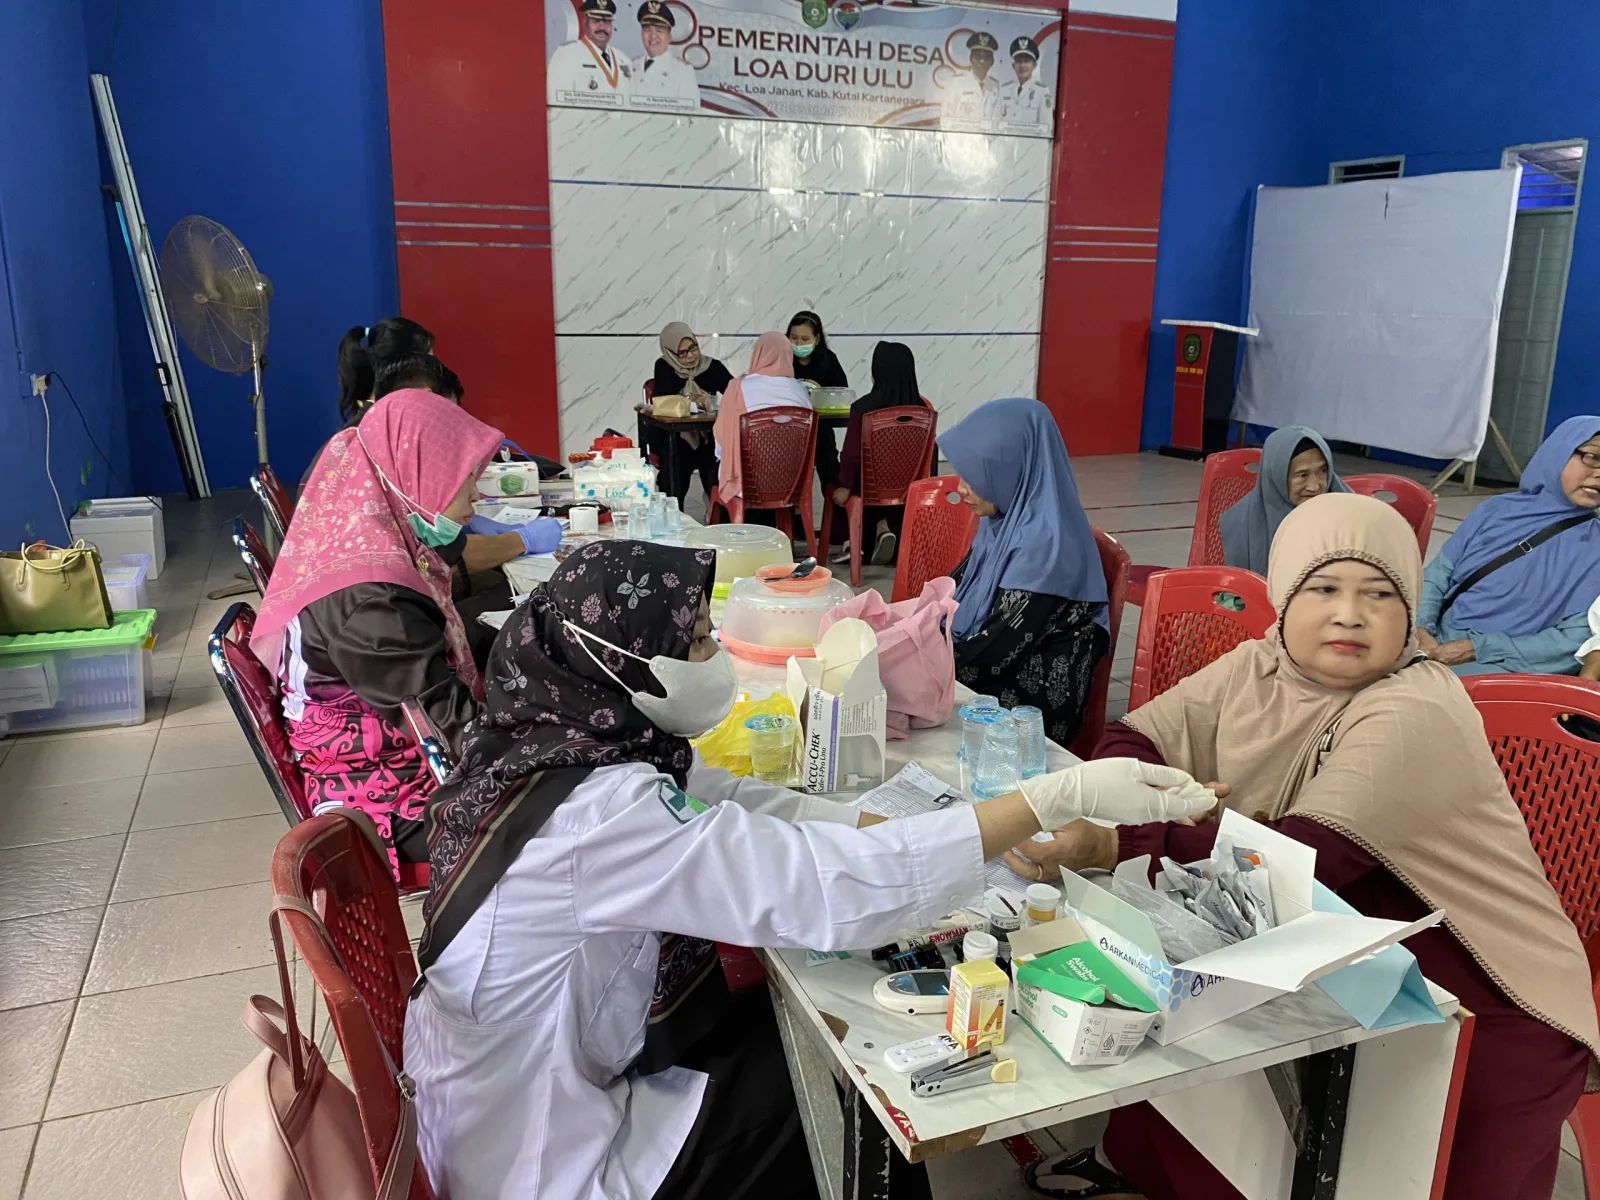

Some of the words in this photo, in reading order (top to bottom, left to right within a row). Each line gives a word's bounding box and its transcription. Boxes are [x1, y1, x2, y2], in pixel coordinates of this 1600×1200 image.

[698, 25, 872, 60] PEMERINTAH
[879, 41, 945, 65] DESA
[734, 56, 789, 80] LOA
[795, 61, 856, 85] DURI
[863, 67, 913, 89] ULU
[745, 84, 766, 95] Loa
[768, 86, 805, 98] Janan,
[806, 88, 831, 99] Kab.
[832, 89, 860, 101] Kutai
[861, 92, 925, 105] Kartanegara
[806, 733, 821, 792] ACCU-CHEK
[817, 761, 826, 792] Safe-T-Pro
[928, 926, 970, 943] SNOWMAN
[1065, 959, 1089, 981] Swabs
[1071, 956, 1100, 982] Alcohol
